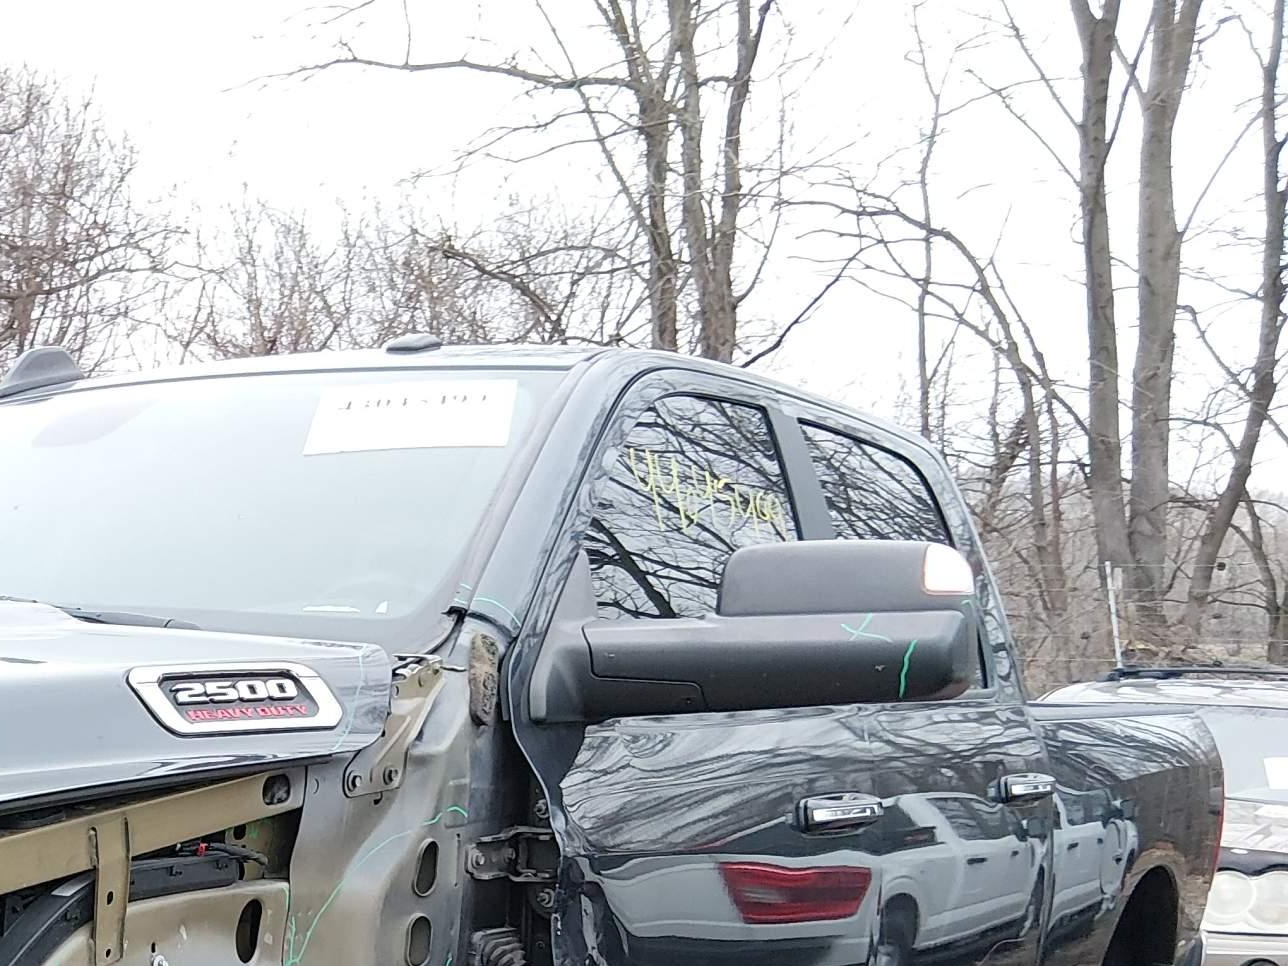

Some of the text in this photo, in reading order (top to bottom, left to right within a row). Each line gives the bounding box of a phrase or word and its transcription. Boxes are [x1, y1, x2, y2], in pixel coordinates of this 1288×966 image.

[170, 678, 298, 706] 2500
[186, 704, 308, 721] HEAVY DUTY
